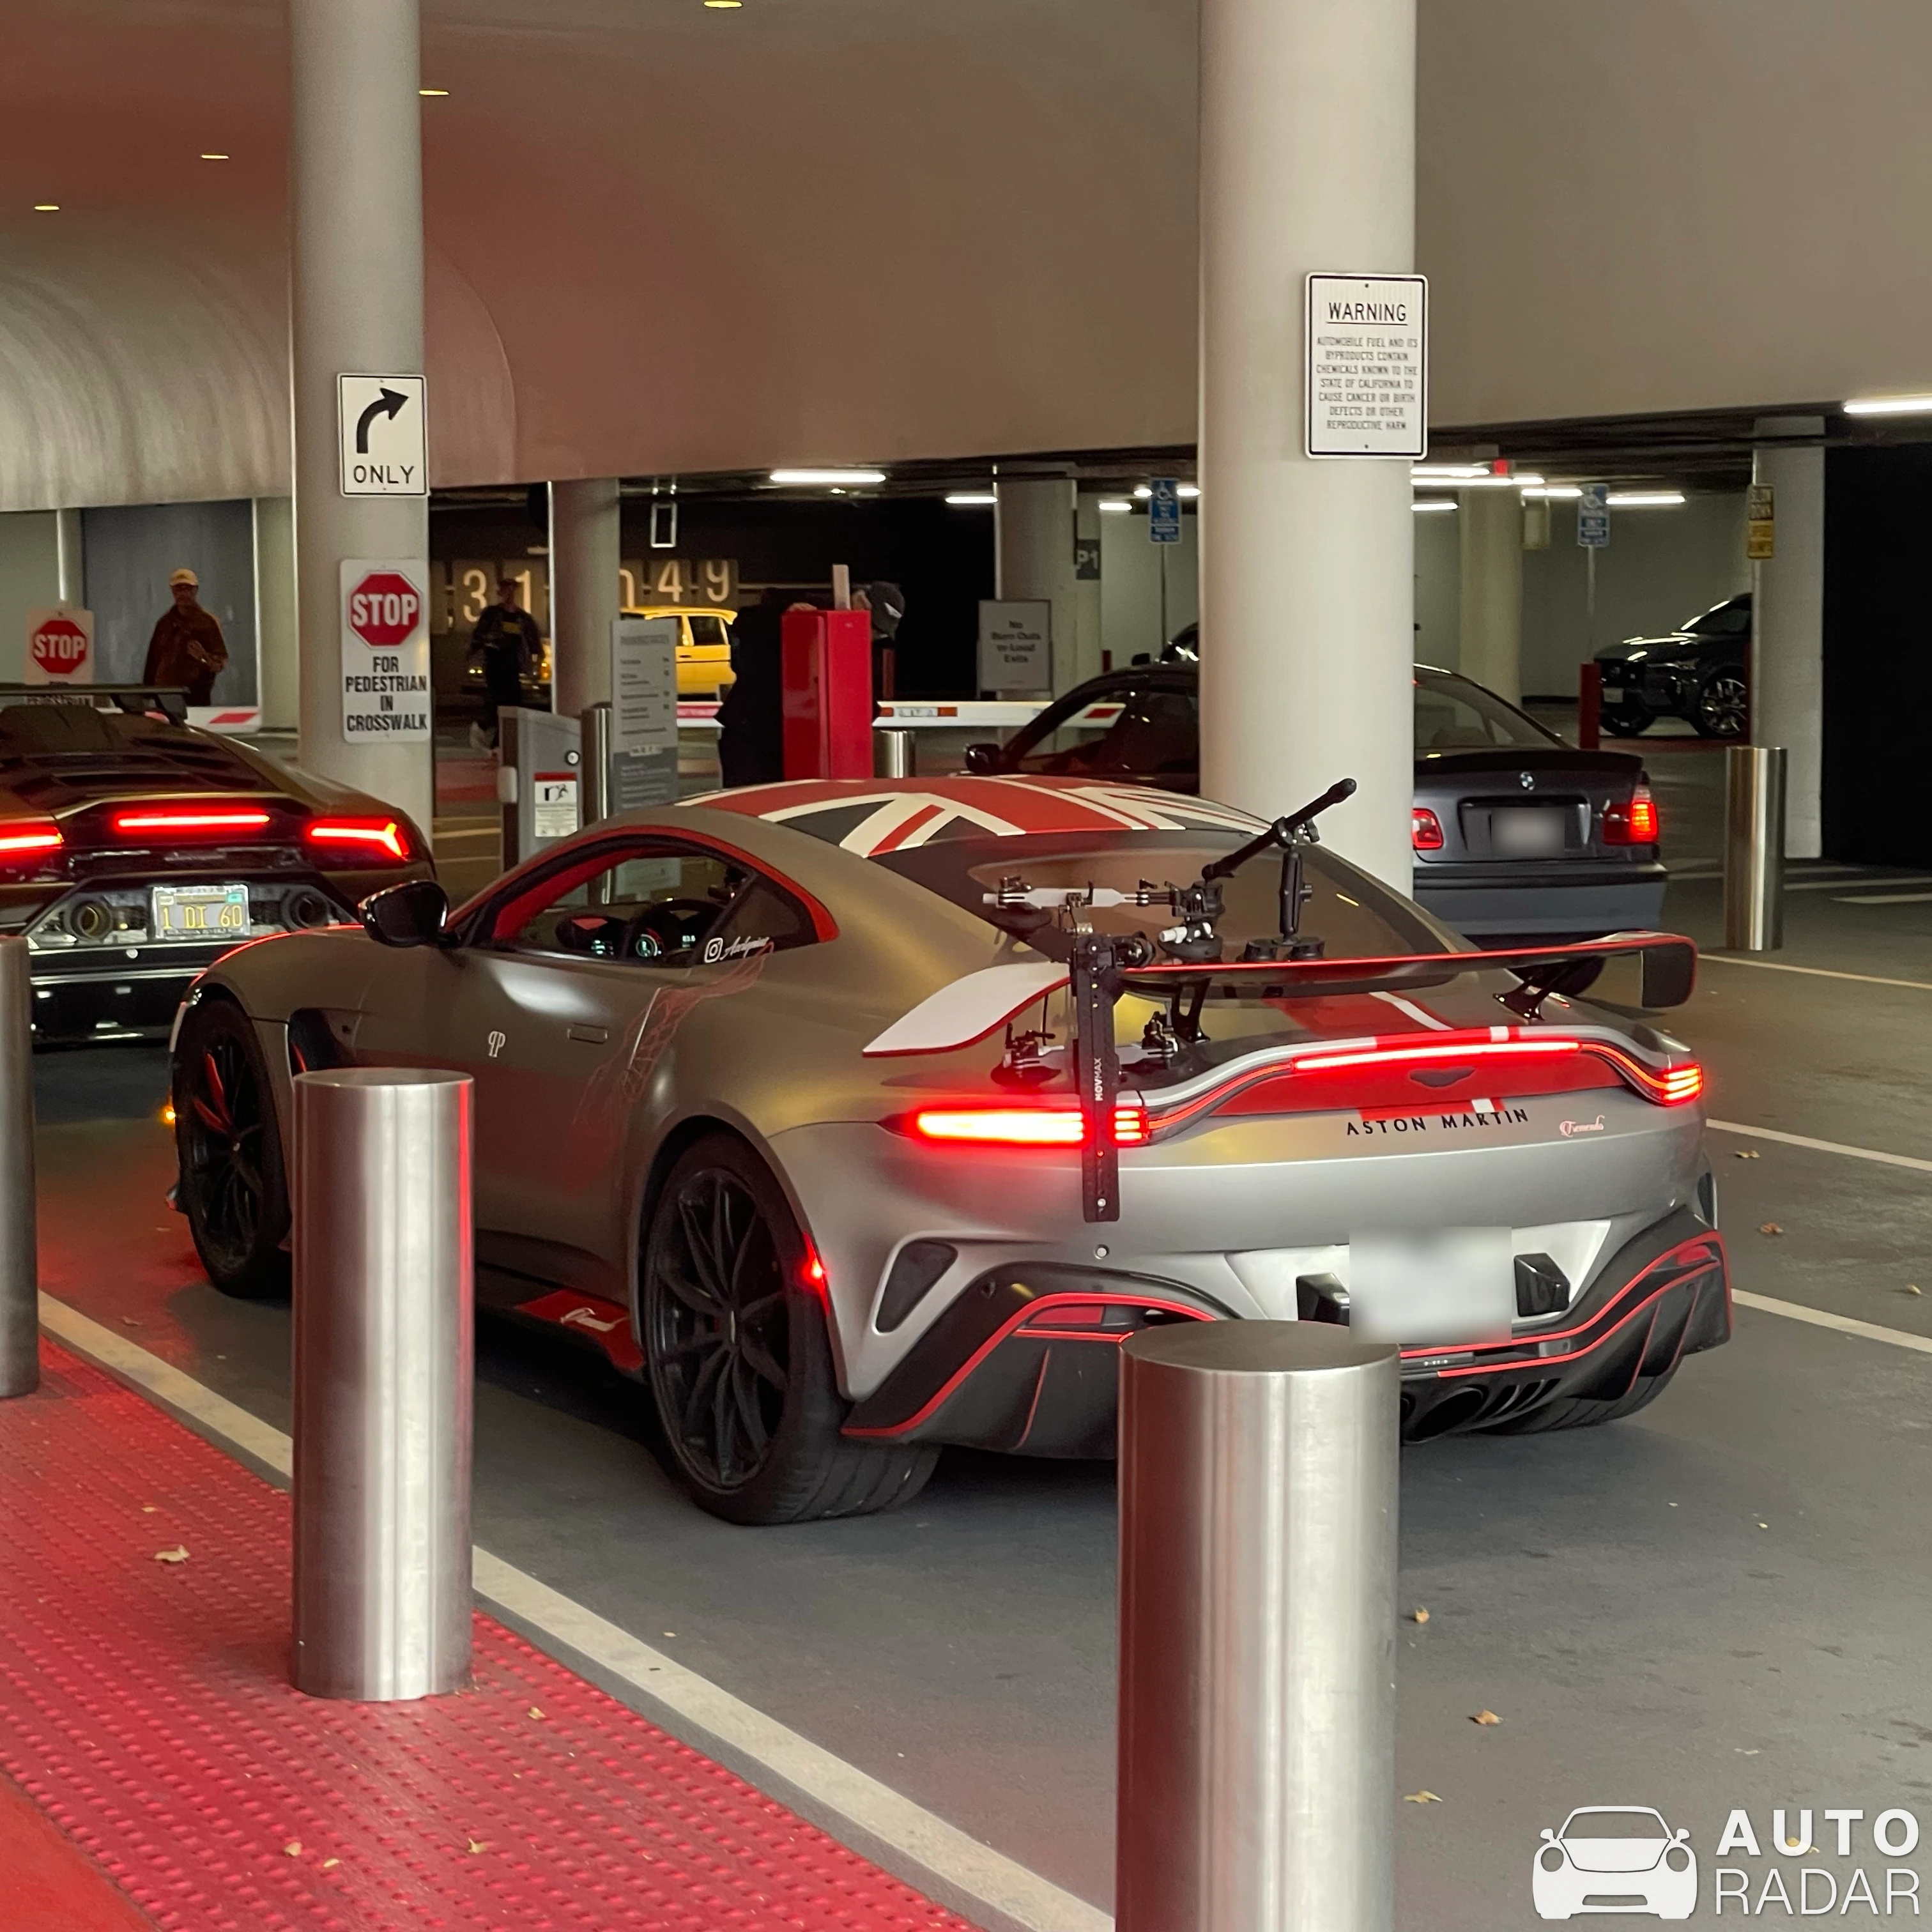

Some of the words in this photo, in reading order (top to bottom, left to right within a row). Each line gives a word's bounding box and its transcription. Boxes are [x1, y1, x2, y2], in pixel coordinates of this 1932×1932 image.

[1328, 302, 1406, 321] WARNING
[1367, 337, 1385, 347] FUEL
[1388, 339, 1404, 348] AND
[1316, 365, 1358, 374] CHEMICALS
[1321, 379, 1342, 388] STATE
[1346, 379, 1355, 388] OF
[1358, 379, 1401, 388] CALIFORNIA
[1319, 392, 1342, 402] CAUSE
[1347, 393, 1376, 402] CANCER
[1330, 406, 1362, 415] DEFECTS
[353, 465, 414, 484] ONLY
[1076, 550, 1098, 569] P1
[352, 593, 417, 626] STOP
[34, 634, 86, 659] STOP
[373, 656, 399, 672] FOR
[346, 676, 427, 693] PEDESTRIAN
[380, 695, 394, 711] IN
[347, 714, 427, 732] CROSSWALK
[162, 905, 172, 930] 1
[1094, 1058, 1103, 1101] MOVMAX
[1347, 1117, 1427, 1136] ASTON
[1441, 1108, 1529, 1129] MARTIN
